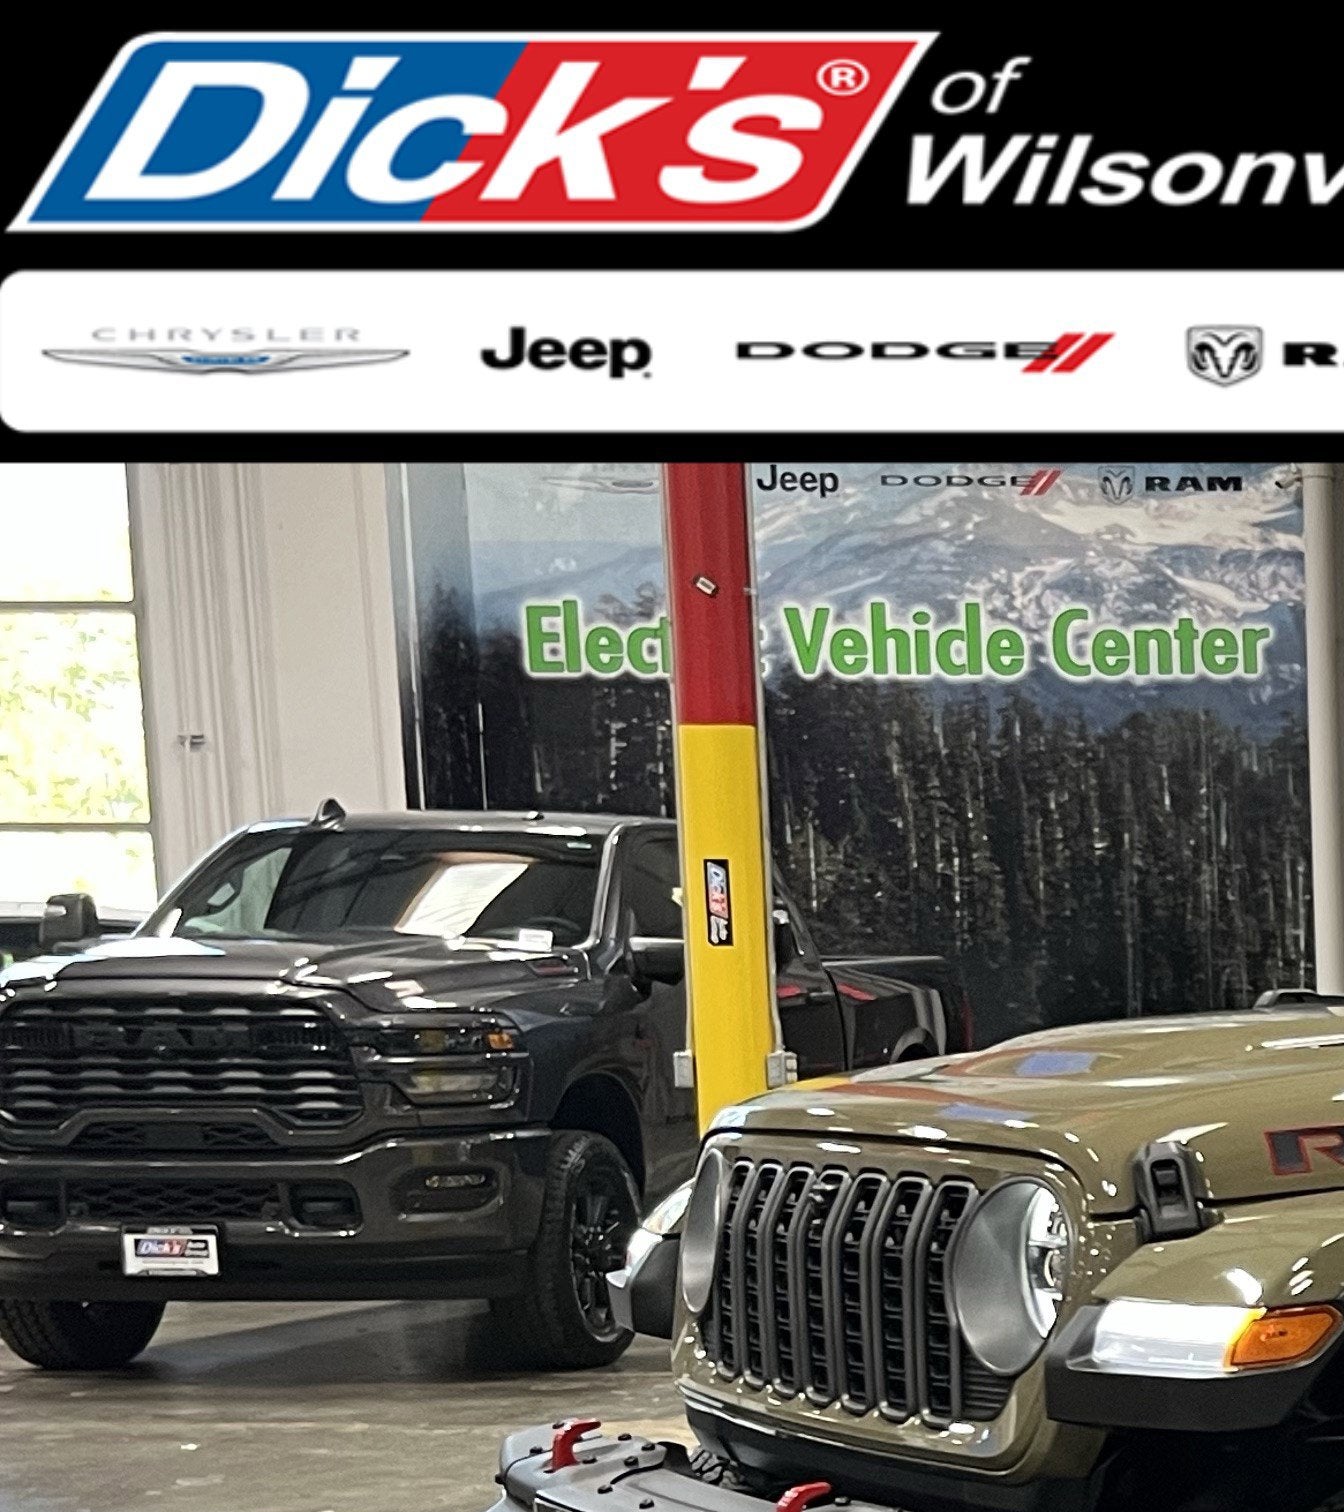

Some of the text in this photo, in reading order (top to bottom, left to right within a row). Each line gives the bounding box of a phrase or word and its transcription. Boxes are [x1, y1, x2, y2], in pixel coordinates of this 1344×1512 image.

[757, 464, 839, 499] Jeep
[880, 474, 1032, 487] DODGE
[1145, 475, 1242, 492] RAM
[783, 602, 1024, 675] Vehicle
[1053, 608, 1270, 676] Center
